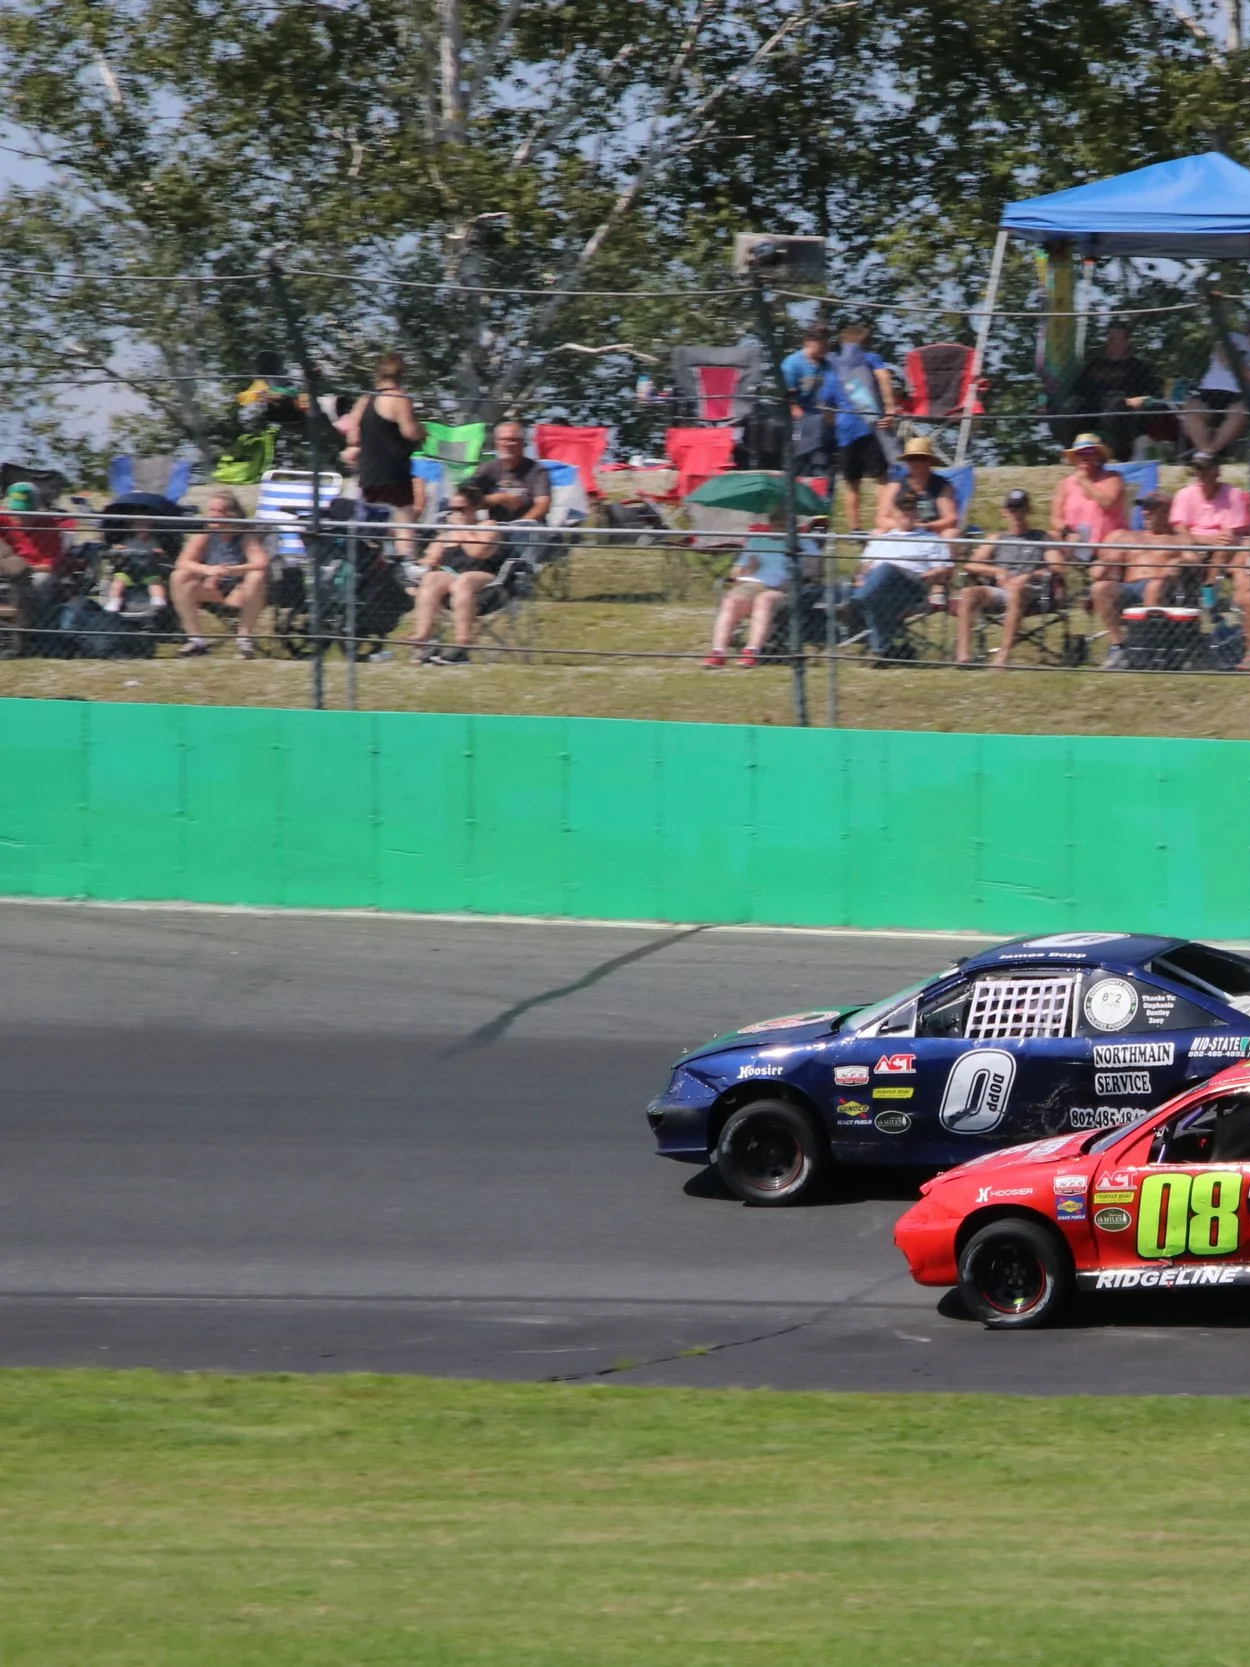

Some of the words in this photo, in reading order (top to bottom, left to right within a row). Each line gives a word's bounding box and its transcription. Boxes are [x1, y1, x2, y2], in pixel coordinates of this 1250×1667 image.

[1190, 1037, 1240, 1051] MID-STATE
[736, 1065, 784, 1079] Hoosier
[875, 1054, 916, 1073] ACT
[939, 1048, 1017, 1134] 0
[986, 1073, 1005, 1112] DOPP
[1096, 1074, 1149, 1093] SERVICE
[1096, 1170, 1137, 1190] ACT
[990, 1188, 1034, 1197] HOOSIER
[1138, 1172, 1242, 1257] 08
[1096, 1269, 1238, 1289] RIDGELINE
